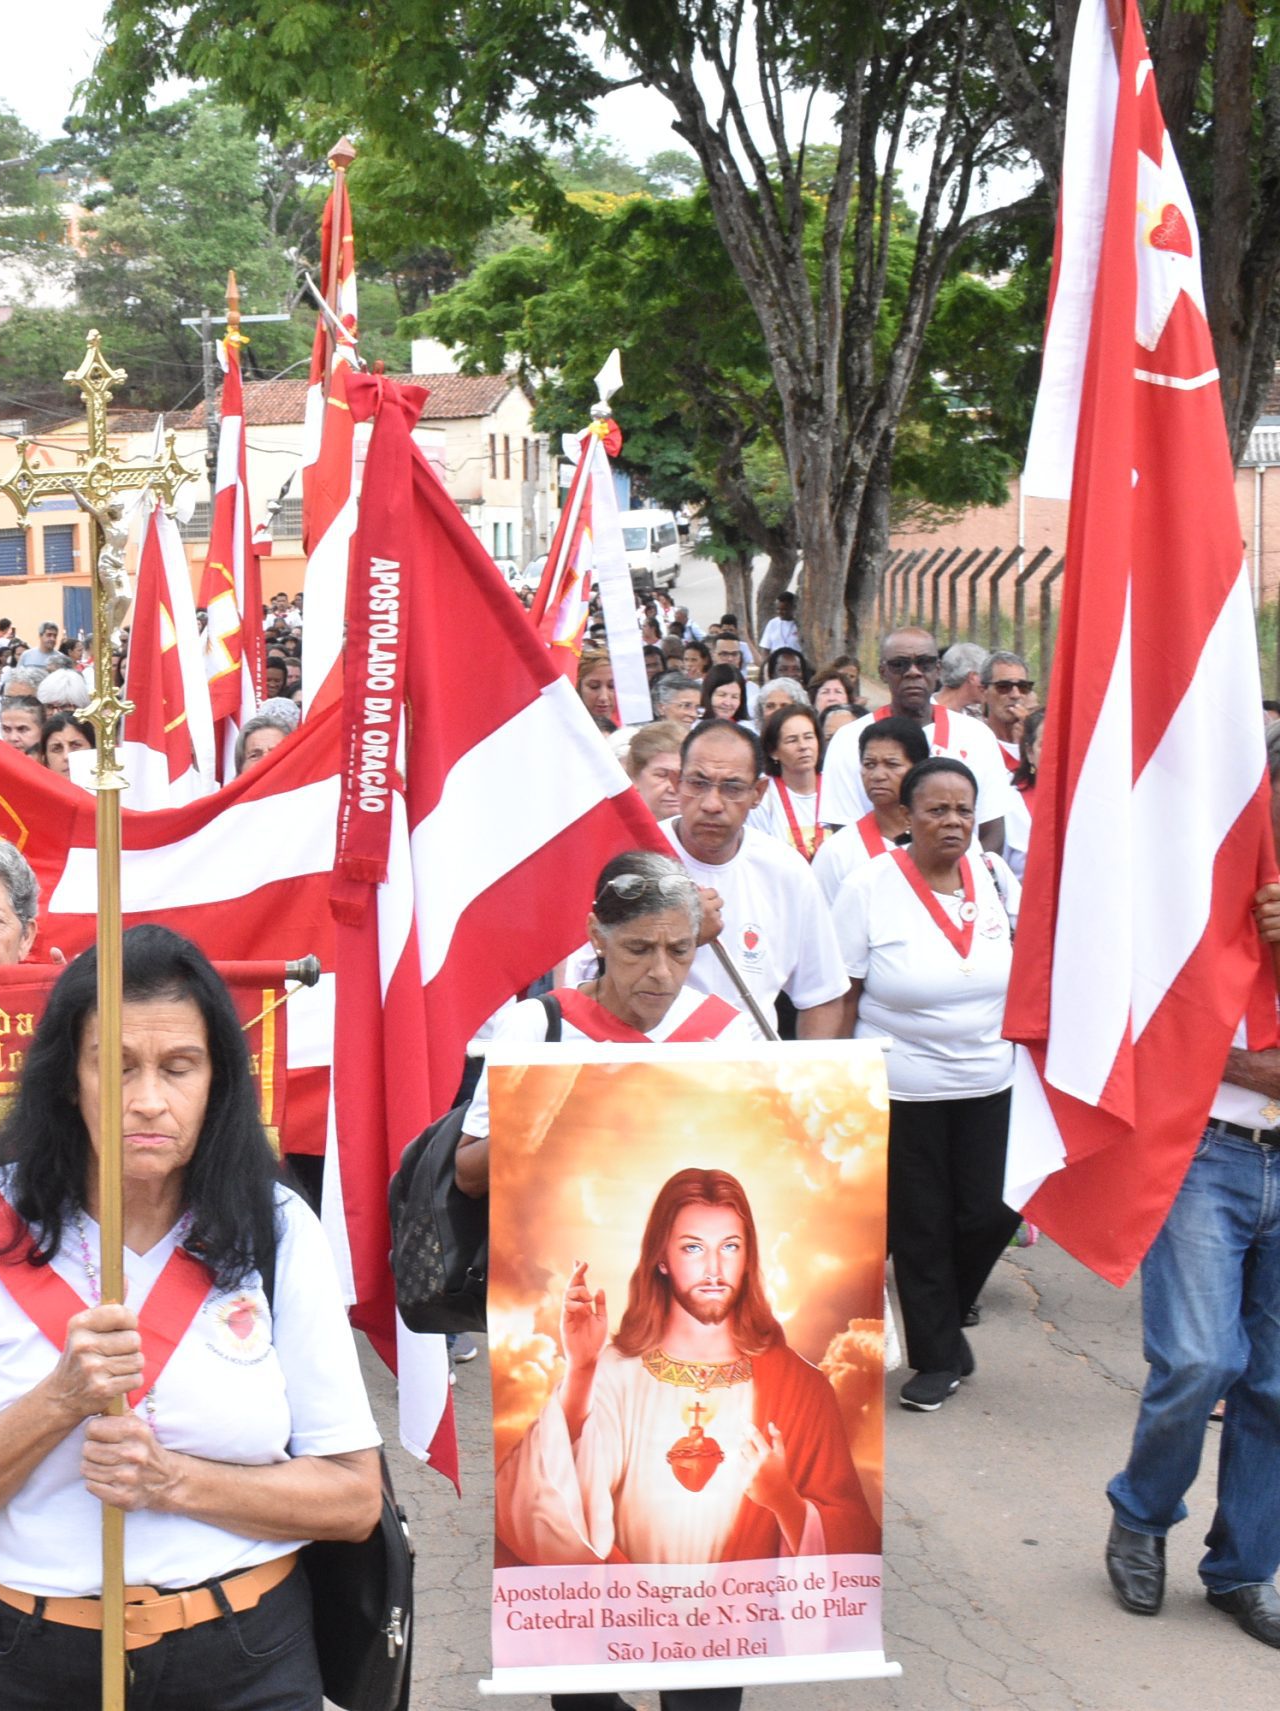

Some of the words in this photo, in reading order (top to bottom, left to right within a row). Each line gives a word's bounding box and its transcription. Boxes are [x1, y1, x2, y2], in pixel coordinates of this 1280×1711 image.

[366, 556, 400, 691] APOSTOLADO
[363, 697, 392, 725] DA
[493, 1581, 601, 1607] Apostolado
[607, 1580, 631, 1599] do
[636, 1580, 717, 1604] Sagrado
[722, 1575, 798, 1597] Coração
[803, 1572, 825, 1590] de
[830, 1570, 881, 1592] Jesus
[506, 1608, 594, 1631] Catedral
[601, 1607, 678, 1629] Basilica
[686, 1607, 710, 1627] de
[716, 1604, 740, 1625] N.
[746, 1602, 785, 1623] Sra.
[791, 1600, 816, 1620] do
[822, 1596, 868, 1618] Pilar
[607, 1641, 644, 1662] São
[650, 1641, 696, 1663] João
[702, 1638, 731, 1658] del
[736, 1637, 768, 1656] Rei
